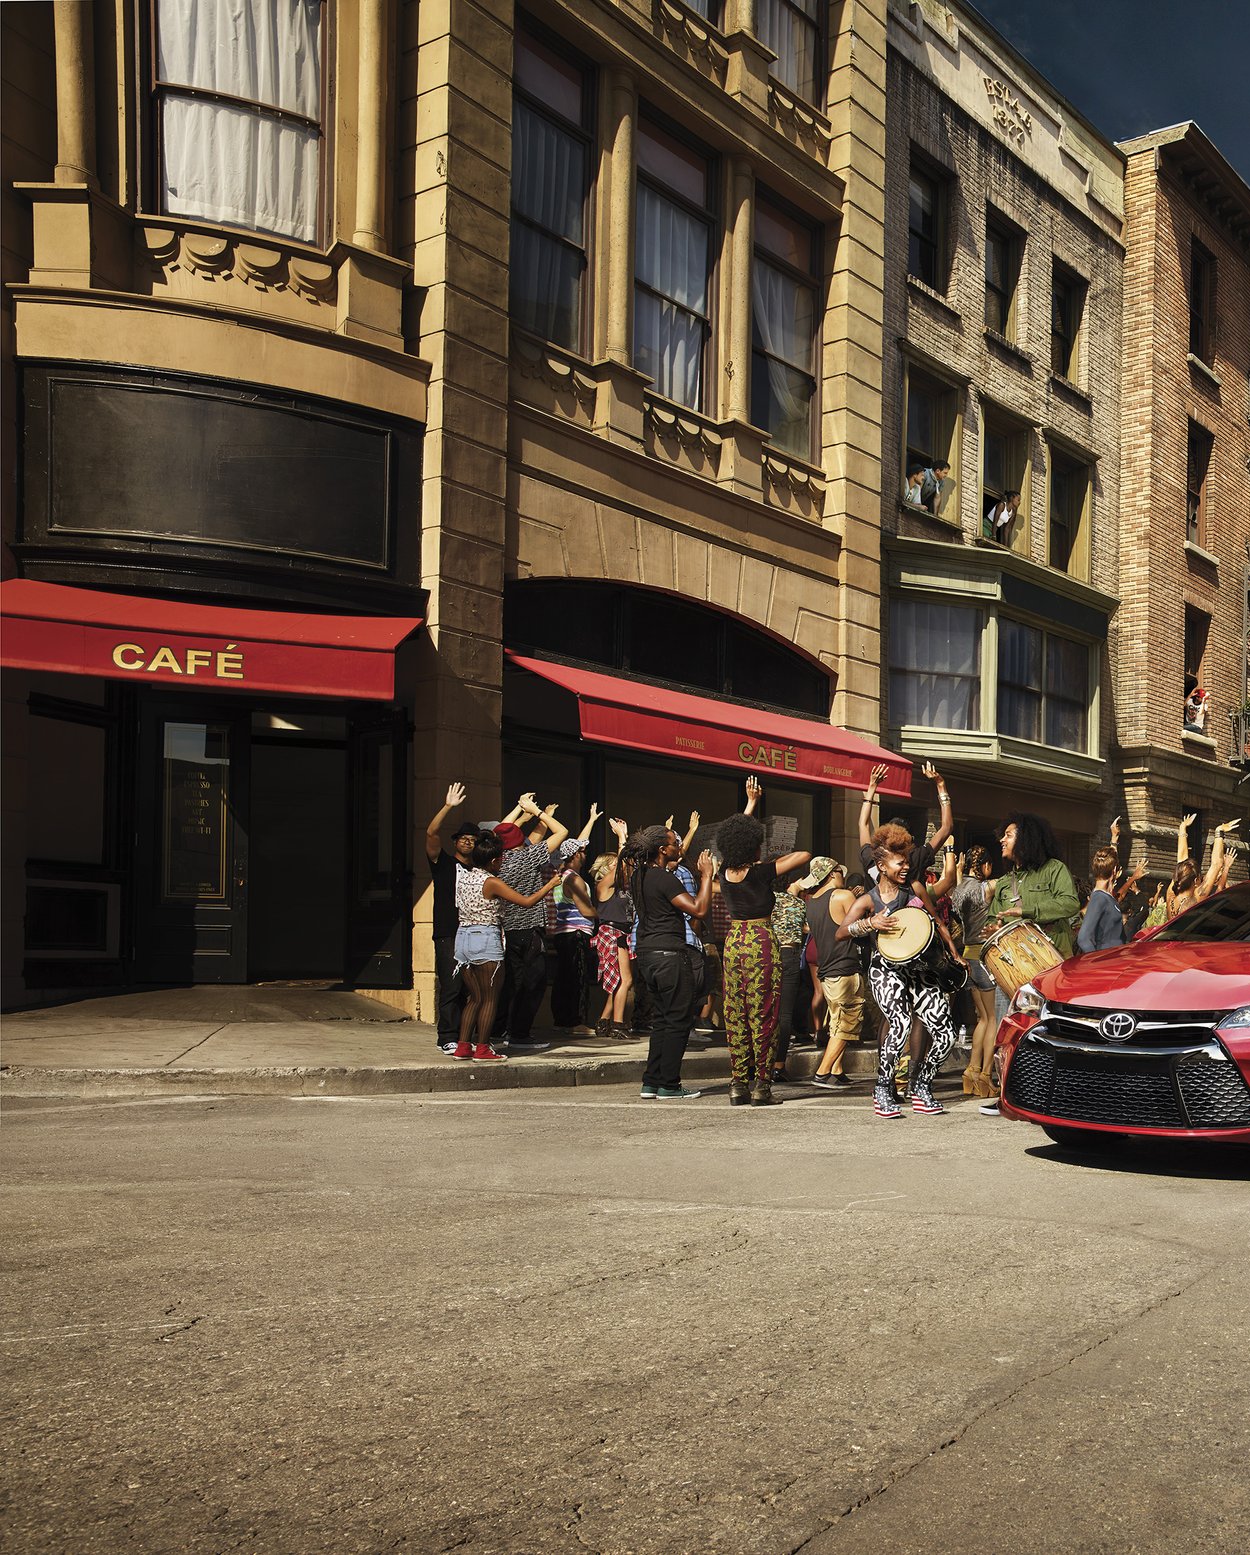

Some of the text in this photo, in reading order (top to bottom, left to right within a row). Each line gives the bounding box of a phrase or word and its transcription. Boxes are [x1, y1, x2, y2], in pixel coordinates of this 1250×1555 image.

[992, 105, 1024, 141] 1877
[112, 643, 244, 678] CAFÉ
[675, 736, 705, 751] PATISSERIE
[738, 742, 798, 771] CAFÉ
[768, 843, 793, 853] CRÊP
